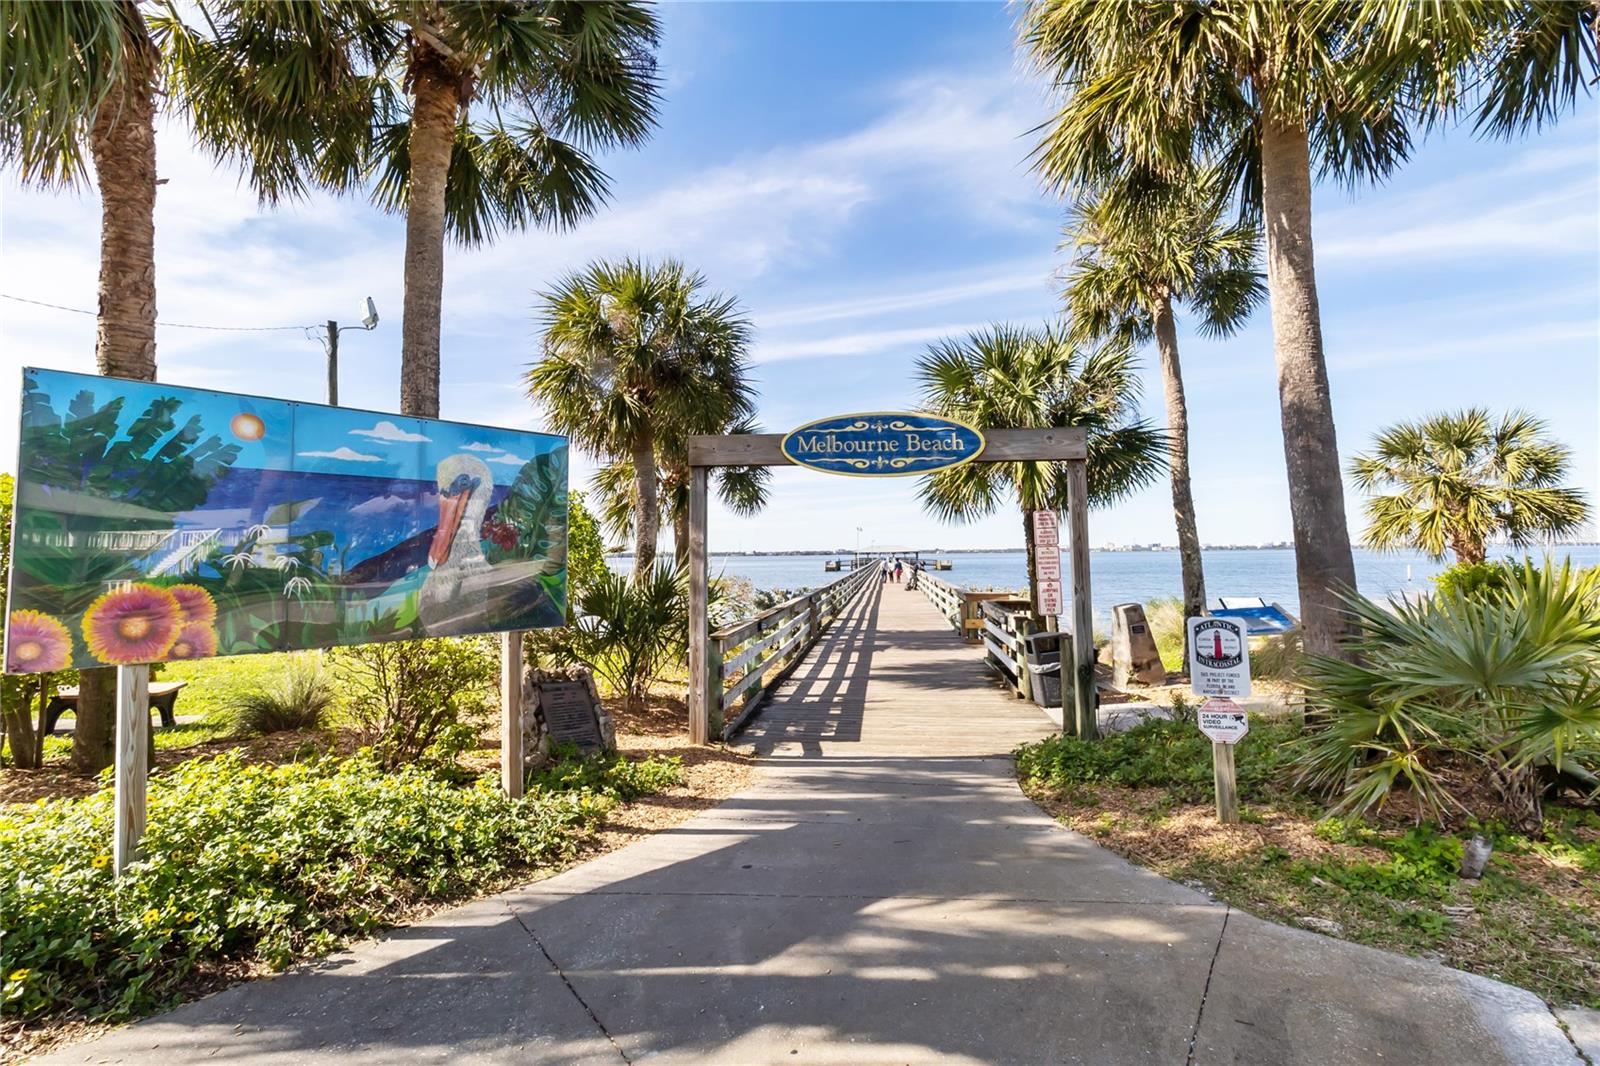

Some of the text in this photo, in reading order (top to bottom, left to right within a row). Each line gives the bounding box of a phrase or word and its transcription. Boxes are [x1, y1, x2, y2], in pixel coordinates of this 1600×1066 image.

[797, 433, 965, 453] Melbourne Beach
[1200, 621, 1234, 630] ATLANTIC
[1198, 655, 1240, 668] INTRACOASTAL
